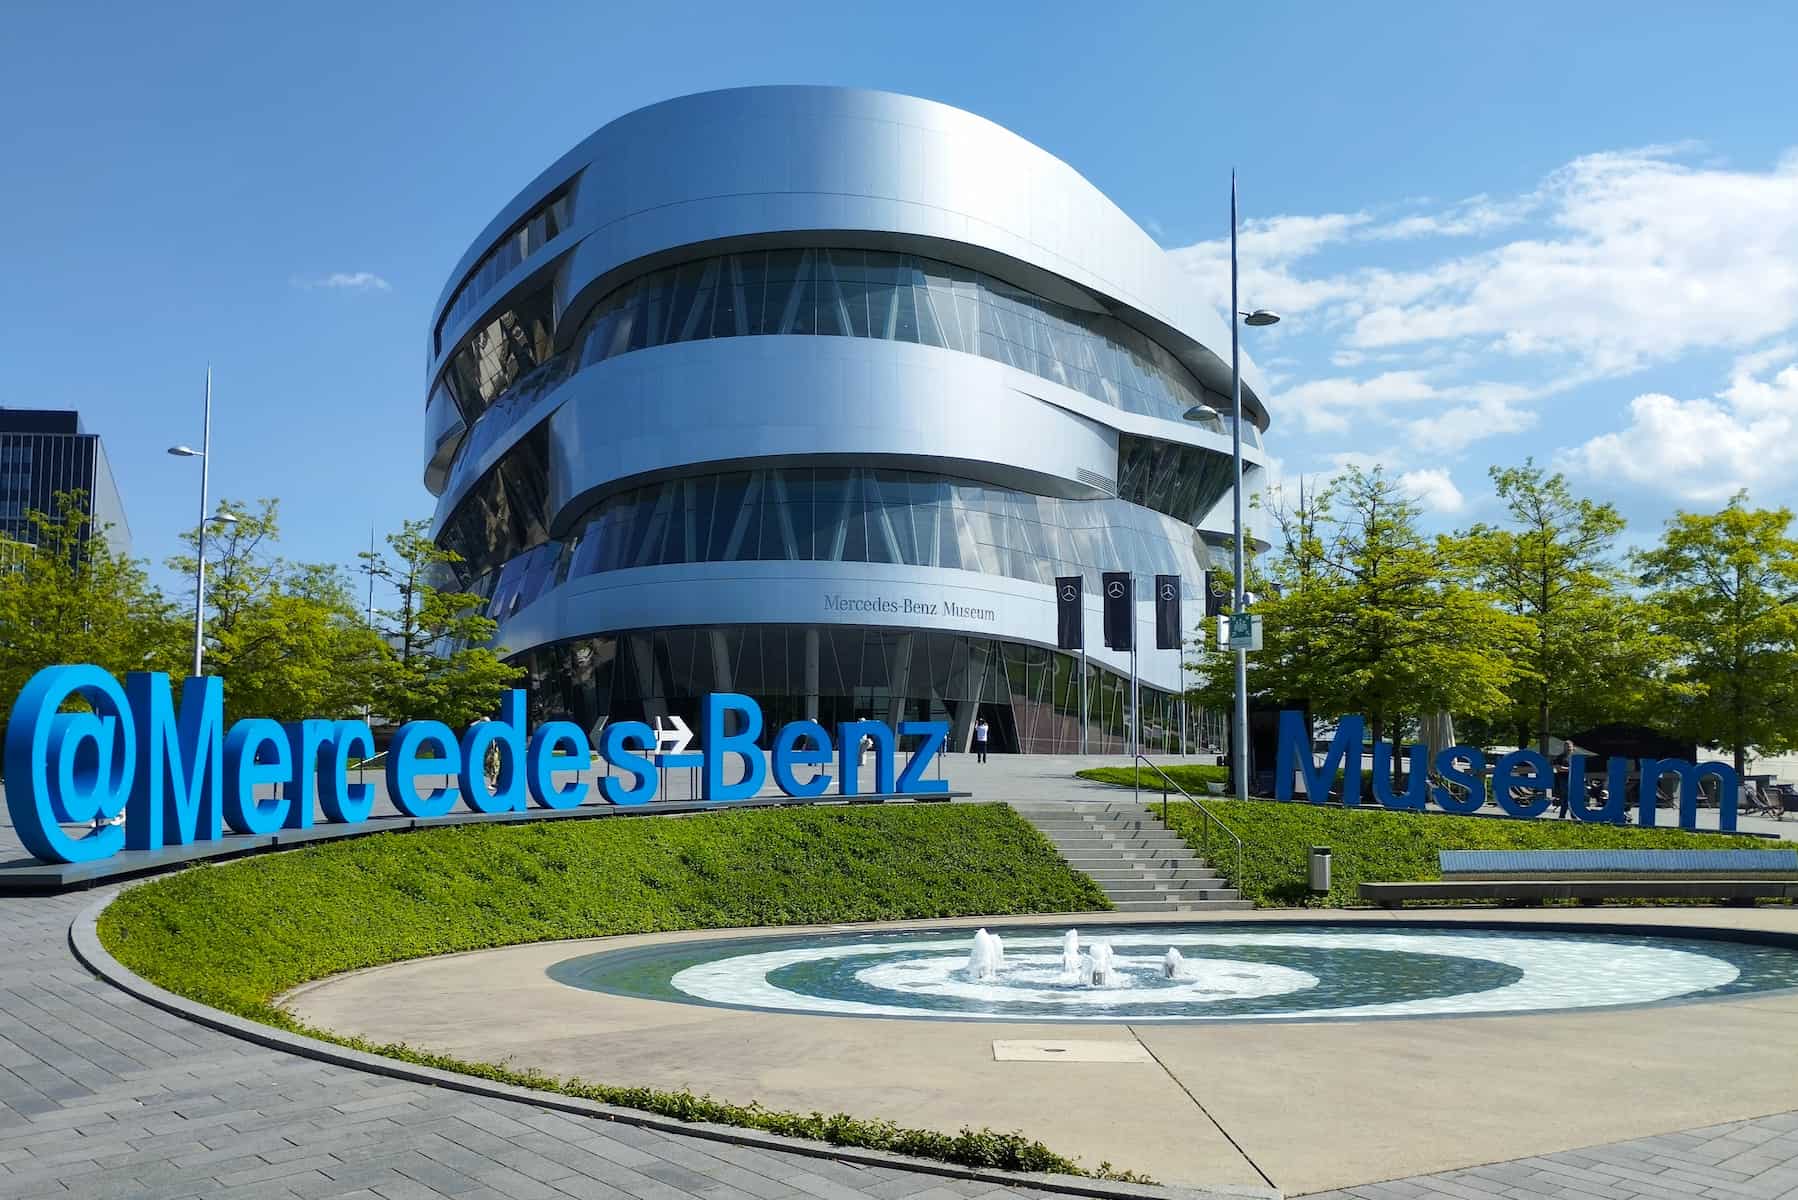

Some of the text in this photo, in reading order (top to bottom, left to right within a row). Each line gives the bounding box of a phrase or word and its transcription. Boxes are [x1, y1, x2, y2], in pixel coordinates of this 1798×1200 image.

[823, 594, 995, 621] Mercedes-Benz Museum
[5, 664, 1737, 863] @Mercedes-Benz Museum
